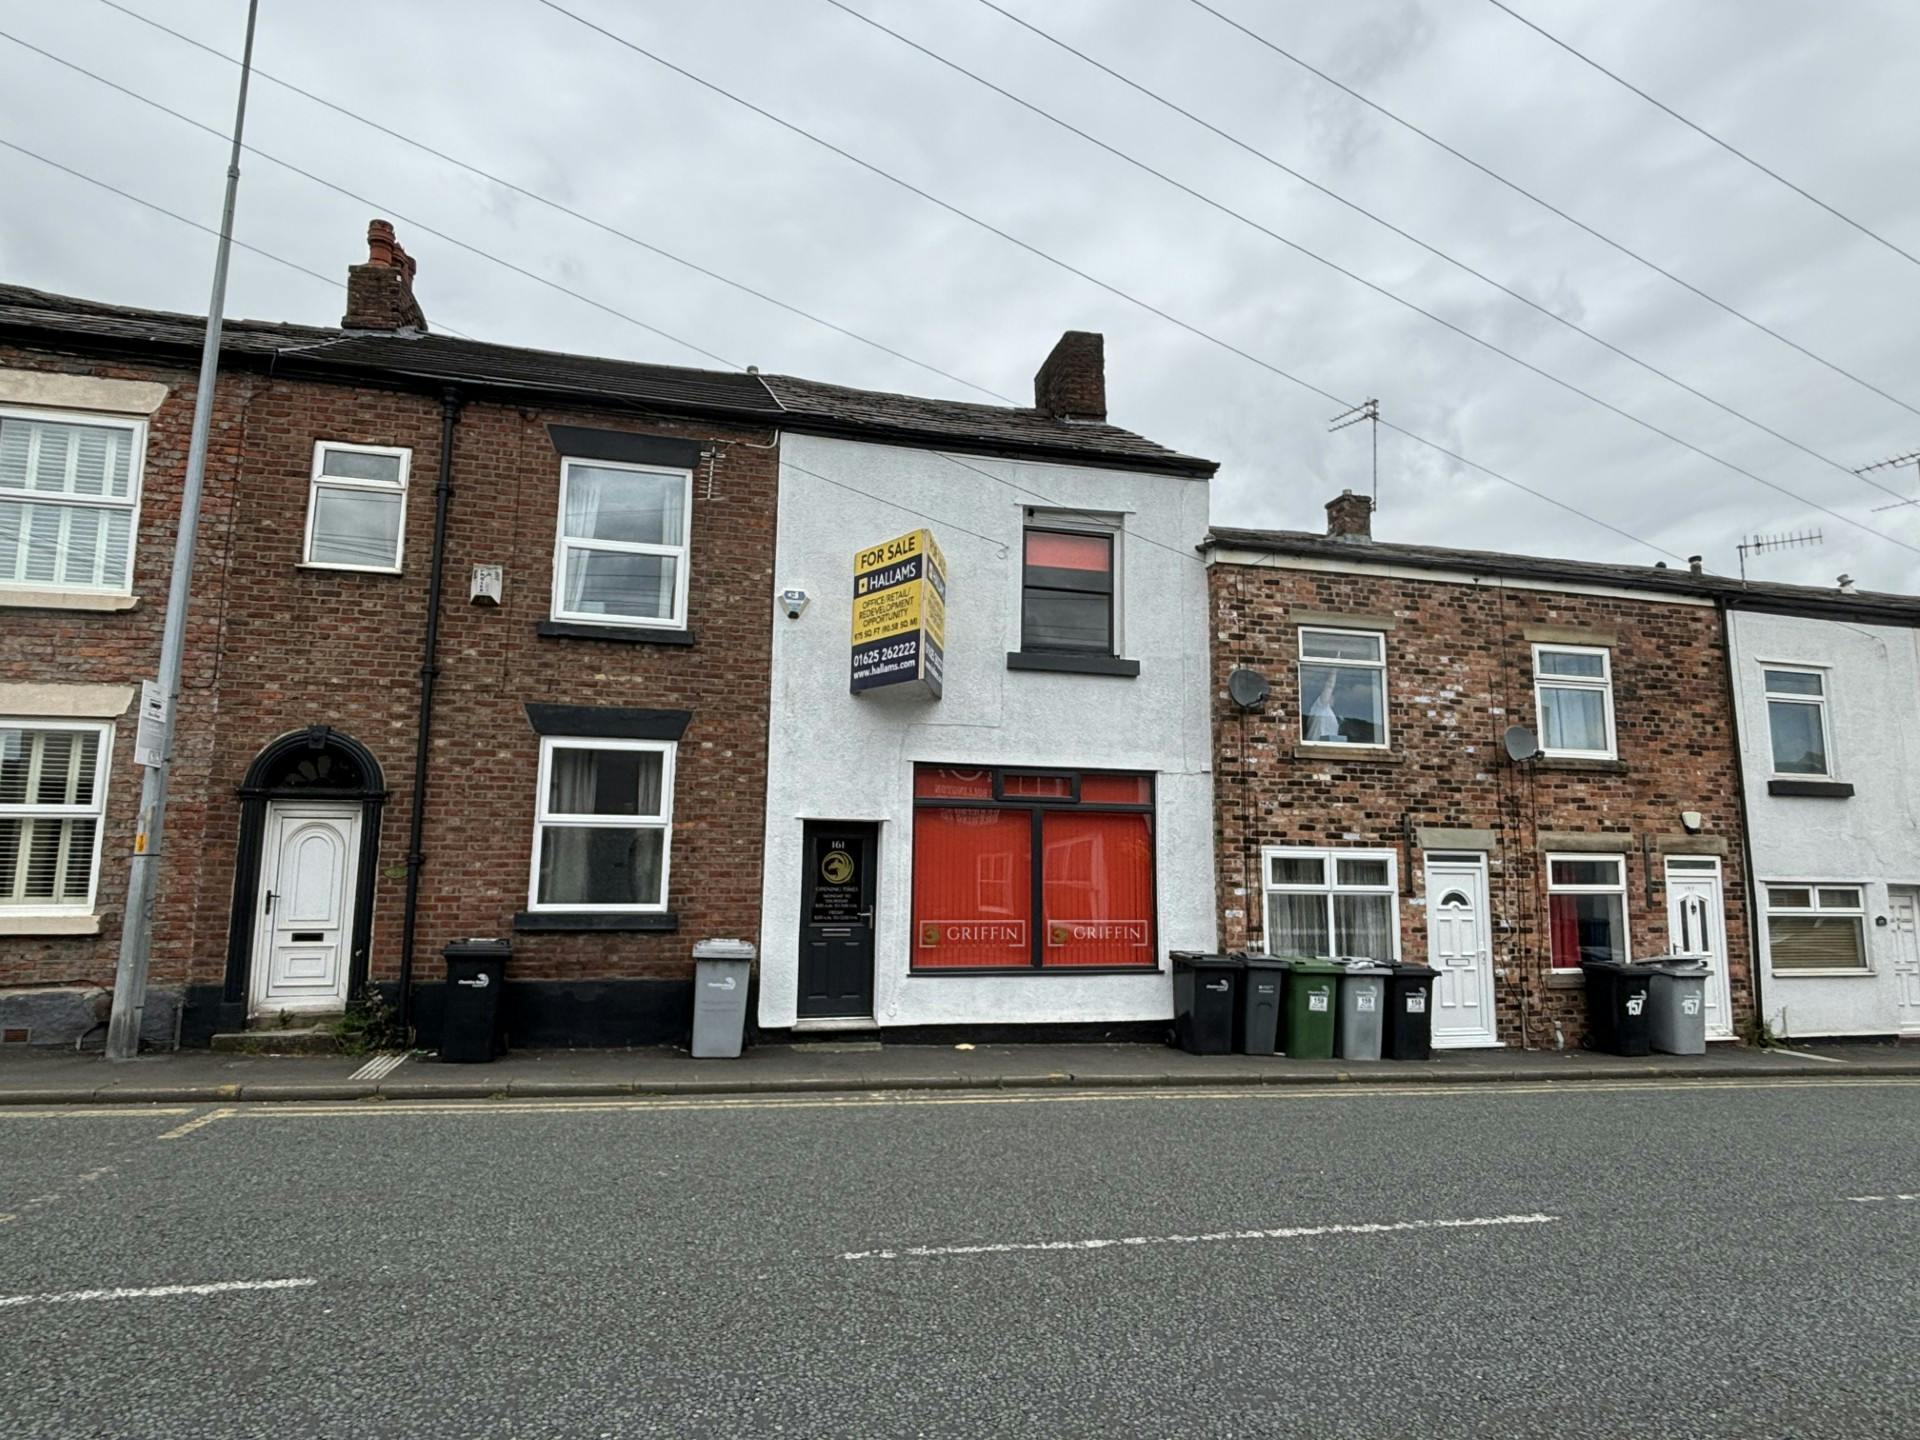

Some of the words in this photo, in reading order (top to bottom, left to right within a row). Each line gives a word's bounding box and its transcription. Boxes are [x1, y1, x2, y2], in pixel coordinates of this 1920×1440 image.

[861, 548, 884, 568] FOR
[888, 536, 915, 560] SALE
[869, 562, 916, 590] HALLAMS
[859, 596, 914, 620] REDEVELOPMENT
[862, 608, 908, 627] OPPORTUNITY
[853, 649, 880, 667] 01625
[881, 641, 916, 660] 262222
[853, 659, 916, 679] www.hallams.com
[831, 840, 845, 849] 161
[946, 926, 1018, 941] GRIFFIN
[1073, 926, 1141, 940] GRIFFIN
[1626, 999, 1643, 1015] 157
[1681, 999, 1700, 1014] 157
